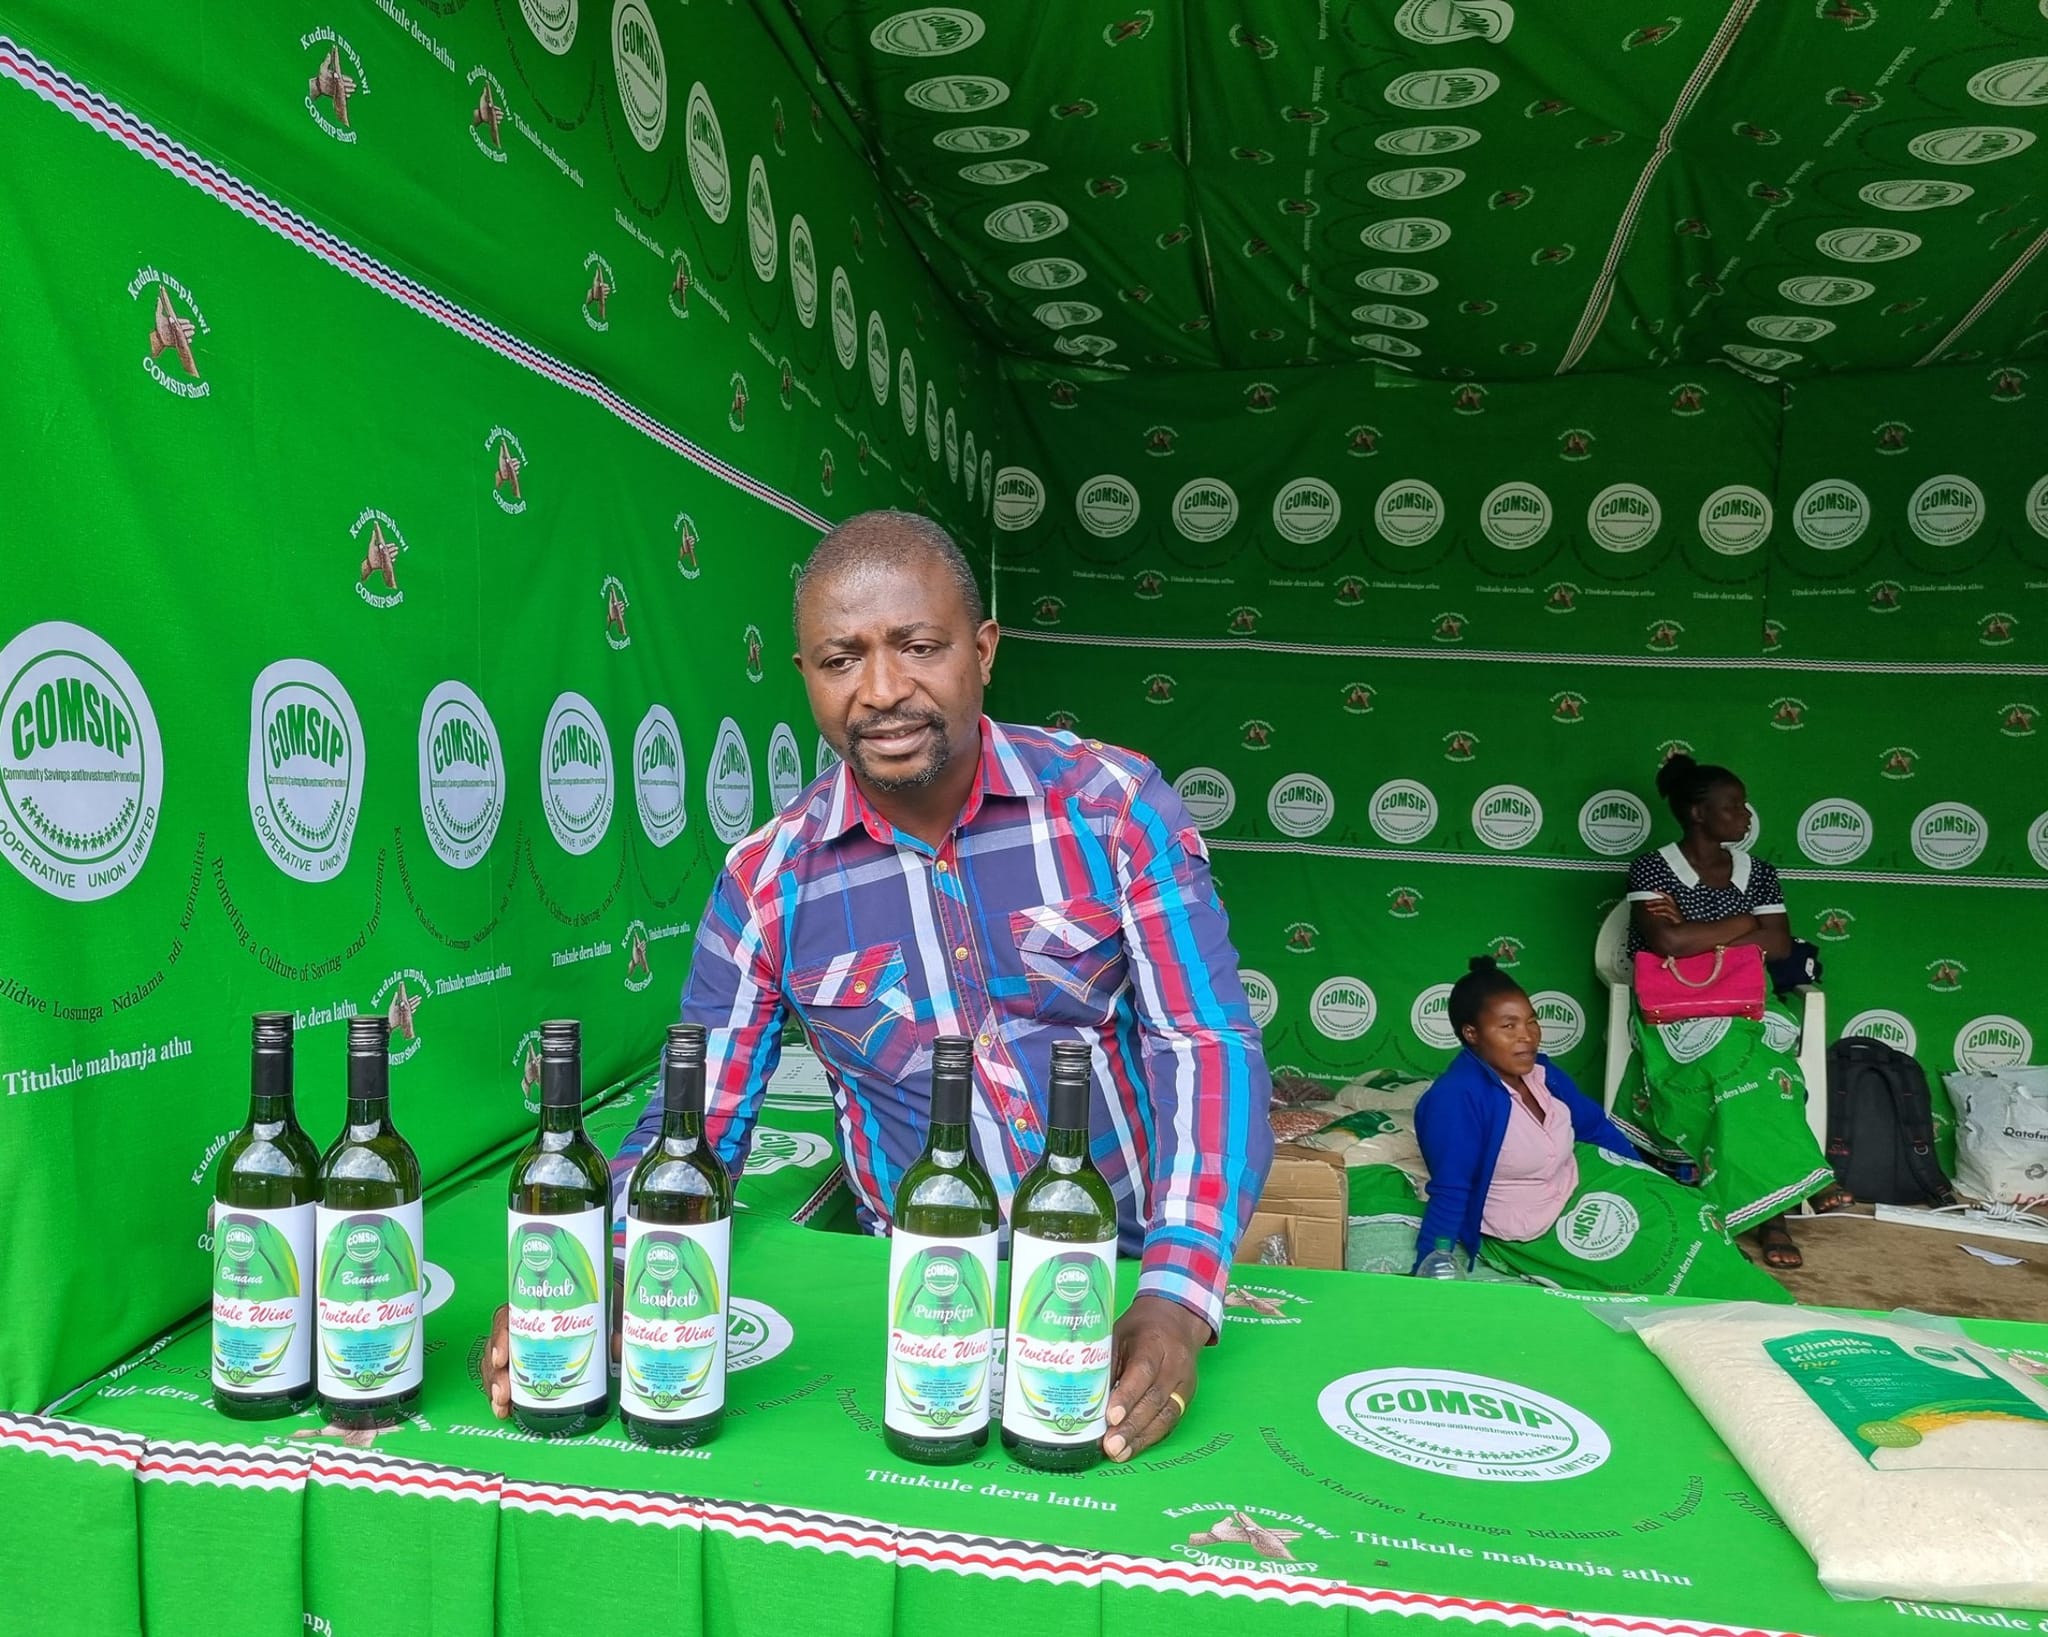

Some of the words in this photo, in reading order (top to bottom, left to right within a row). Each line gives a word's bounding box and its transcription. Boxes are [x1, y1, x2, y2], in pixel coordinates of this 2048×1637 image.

[411, 21, 431, 52] dera
[433, 38, 455, 72] lathu
[622, 20, 661, 84] COMSIP
[301, 26, 335, 50] Kudula
[338, 35, 370, 95] umphawi
[304, 96, 336, 139] COMSIP
[337, 128, 357, 144] Sharp
[128, 265, 160, 300] Kudula
[163, 272, 210, 334] umphawi
[143, 357, 187, 397] COMSIP
[188, 382, 210, 398] Sharp
[485, 425, 502, 451] Kudula
[492, 489, 514, 514] COMSIP
[1088, 488, 1129, 506] COMSIP
[1184, 491, 1228, 510] COMSIP
[1284, 491, 1330, 510] COMSIP
[1387, 493, 1434, 512] COMSIP
[1493, 496, 1541, 515] COMSIP
[1601, 498, 1649, 517] COMSIP
[1712, 499, 1761, 520] COMSIP
[1807, 493, 1858, 515] COMSIP
[1921, 489, 1972, 511] COMSIP
[349, 507, 375, 539] Kudula
[376, 509, 408, 552] umphawi
[355, 582, 386, 608] COMSIP
[386, 591, 404, 608] Sharp
[12, 678, 131, 760] COMSIP
[268, 703, 344, 769] COMSIP
[433, 719, 489, 774] COMSIP
[552, 724, 602, 774] COMSIP
[3, 768, 44, 782] Community
[1181, 780, 1225, 798] COMSIP
[1279, 786, 1324, 804] COMSIP
[1381, 792, 1427, 811] COMSIP
[1484, 798, 1531, 817] COMSIP
[1591, 803, 1639, 823] COMSIP
[424, 805, 460, 860] COOPERATIVE
[1811, 812, 1860, 832] COMSIP
[1926, 816, 1976, 836] COMSIP
[88, 861, 127, 888] UNION
[128, 806, 156, 866] LIMITED
[254, 805, 312, 872] COOPERATIVE
[319, 852, 342, 873] UNION
[53, 1001, 103, 1022] Losunga
[112, 970, 164, 1014] Ndalama
[168, 936, 183, 965] ndi
[180, 831, 206, 932] Kupindulitsa
[212, 855, 250, 947] Promoting
[259, 947, 297, 981] Culture
[300, 965, 310, 982] of
[311, 954, 342, 981] Saving
[346, 932, 367, 959] and
[552, 951, 579, 967] Titukule
[579, 946, 594, 961] dera
[593, 941, 612, 956] lathu
[371, 973, 401, 1008] Kudula
[403, 969, 434, 999] umphawi
[435, 976, 465, 996] Titukule
[465, 968, 495, 989] mabanja
[495, 964, 512, 979] athu
[1322, 990, 1367, 1009] COMSIP
[309, 1007, 332, 1028] dera
[333, 1000, 358, 1022] lathu
[404, 1037, 422, 1063] Sharp
[1968, 1029, 2021, 1050] COMSIP
[2, 1059, 83, 1097] Titukule
[86, 1042, 156, 1078] mabanja
[160, 1036, 192, 1062] athu
[1723, 1089, 1738, 1100] dera
[1739, 1082, 1758, 1094] lathu
[192, 1135, 226, 1184] Kudula
[227, 1232, 252, 1244] COMSIP
[347, 1232, 378, 1245] COMSIP
[221, 1267, 264, 1284] Banana
[342, 1271, 390, 1285] Banana
[518, 1279, 574, 1297] Baobab
[639, 1287, 698, 1306] Baobab
[249, 1305, 293, 1322] Wine
[320, 1302, 370, 1323] Twitule
[377, 1301, 415, 1322] Wine
[552, 1315, 593, 1332] Wine
[913, 1304, 974, 1323] Pumpkin
[1042, 1311, 1101, 1330] Pumpkin
[624, 1316, 668, 1343] Twitule
[674, 1324, 715, 1342] Wine
[893, 1332, 947, 1359] Twitule
[1015, 1337, 1074, 1365] Twitule
[1790, 1347, 1892, 1363] Kilombero
[142, 1385, 198, 1401] dera
[757, 1373, 834, 1410] Kupindulitsa
[1367, 1388, 1553, 1430] COMSIP
[448, 1424, 545, 1445] Titukule
[1354, 1412, 1408, 1425] Community
[1408, 1417, 1446, 1430] Savings
[1464, 1422, 1519, 1438] Investment
[1519, 1430, 1572, 1442] Promotion
[972, 1459, 1000, 1471] of
[1097, 1464, 1136, 1479] and
[1147, 1430, 1235, 1473] Investments
[1336, 1423, 1459, 1472] COOPERATIVE
[1478, 1466, 1540, 1479] UNION
[1546, 1452, 1600, 1477] LIMITED
[865, 1468, 973, 1494] Titukule
[980, 1484, 1040, 1504] dera
[1048, 1491, 1118, 1512] lathu
[1162, 1502, 1236, 1518] Kudula
[1245, 1504, 1341, 1540] umphawi
[1318, 1478, 1407, 1515] Khalidwe
[1416, 1511, 1512, 1537] Losunga
[1527, 1529, 1622, 1540] Ndalama
[1632, 1518, 1662, 1534] ndi
[1170, 1544, 1255, 1570] COMSIP
[1260, 1561, 1318, 1575] Sharp
[1350, 1529, 1474, 1559] Titukule
[1482, 1549, 1614, 1578] mabanja
[1622, 1570, 1694, 1587] athu
[1885, 1599, 2031, 1632] Titukule
